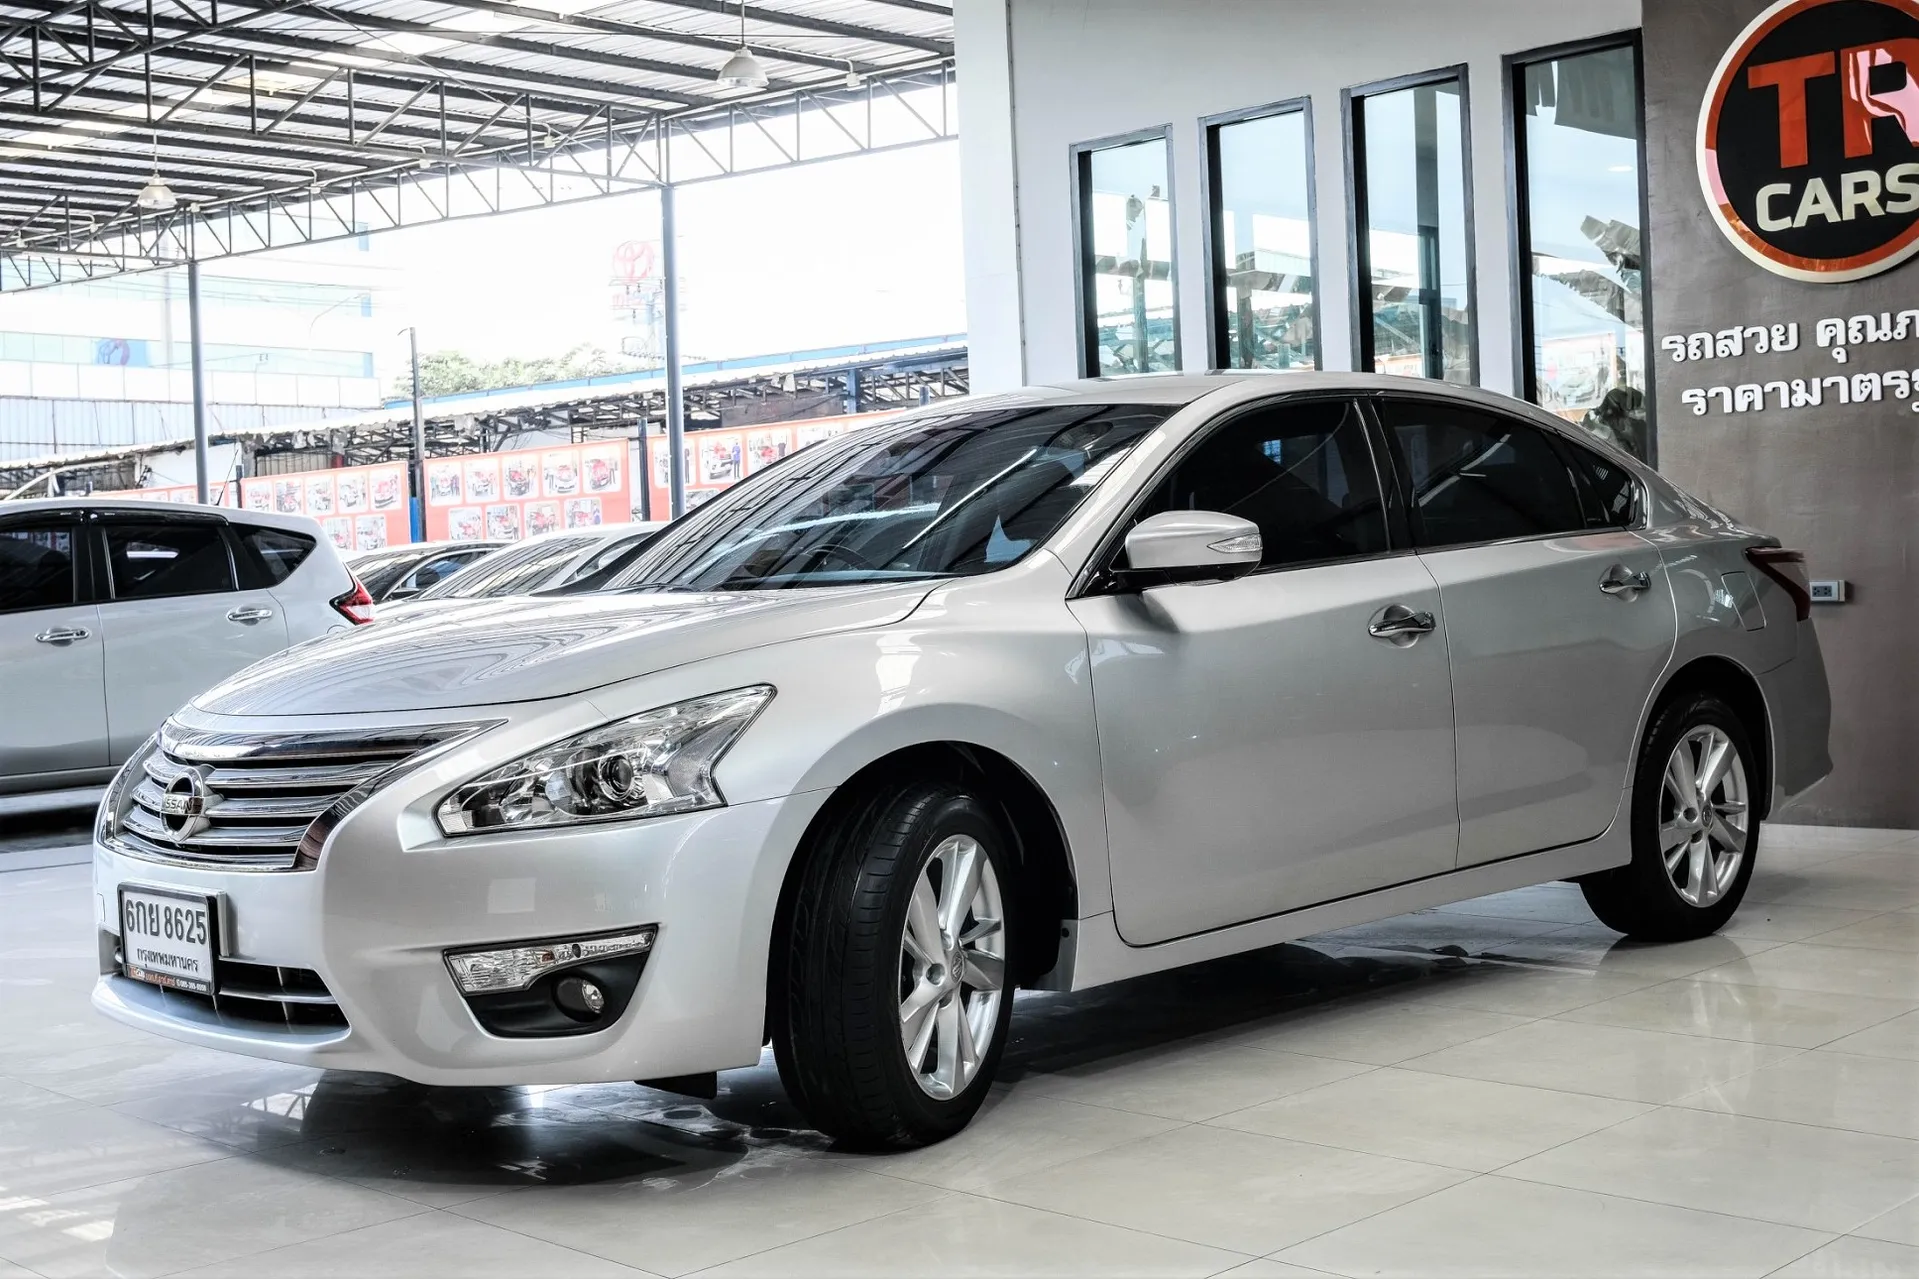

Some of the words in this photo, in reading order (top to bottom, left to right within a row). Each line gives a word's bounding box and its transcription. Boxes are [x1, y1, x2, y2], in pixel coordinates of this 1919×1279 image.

[1747, 37, 1919, 169] TR
[1755, 162, 1919, 232] CARS
[1661, 321, 1799, 363] รถสวย
[125, 899, 160, 937] 6กย
[164, 905, 207, 945] 8625
[137, 947, 199, 973] กรุงเทพมหานคร
